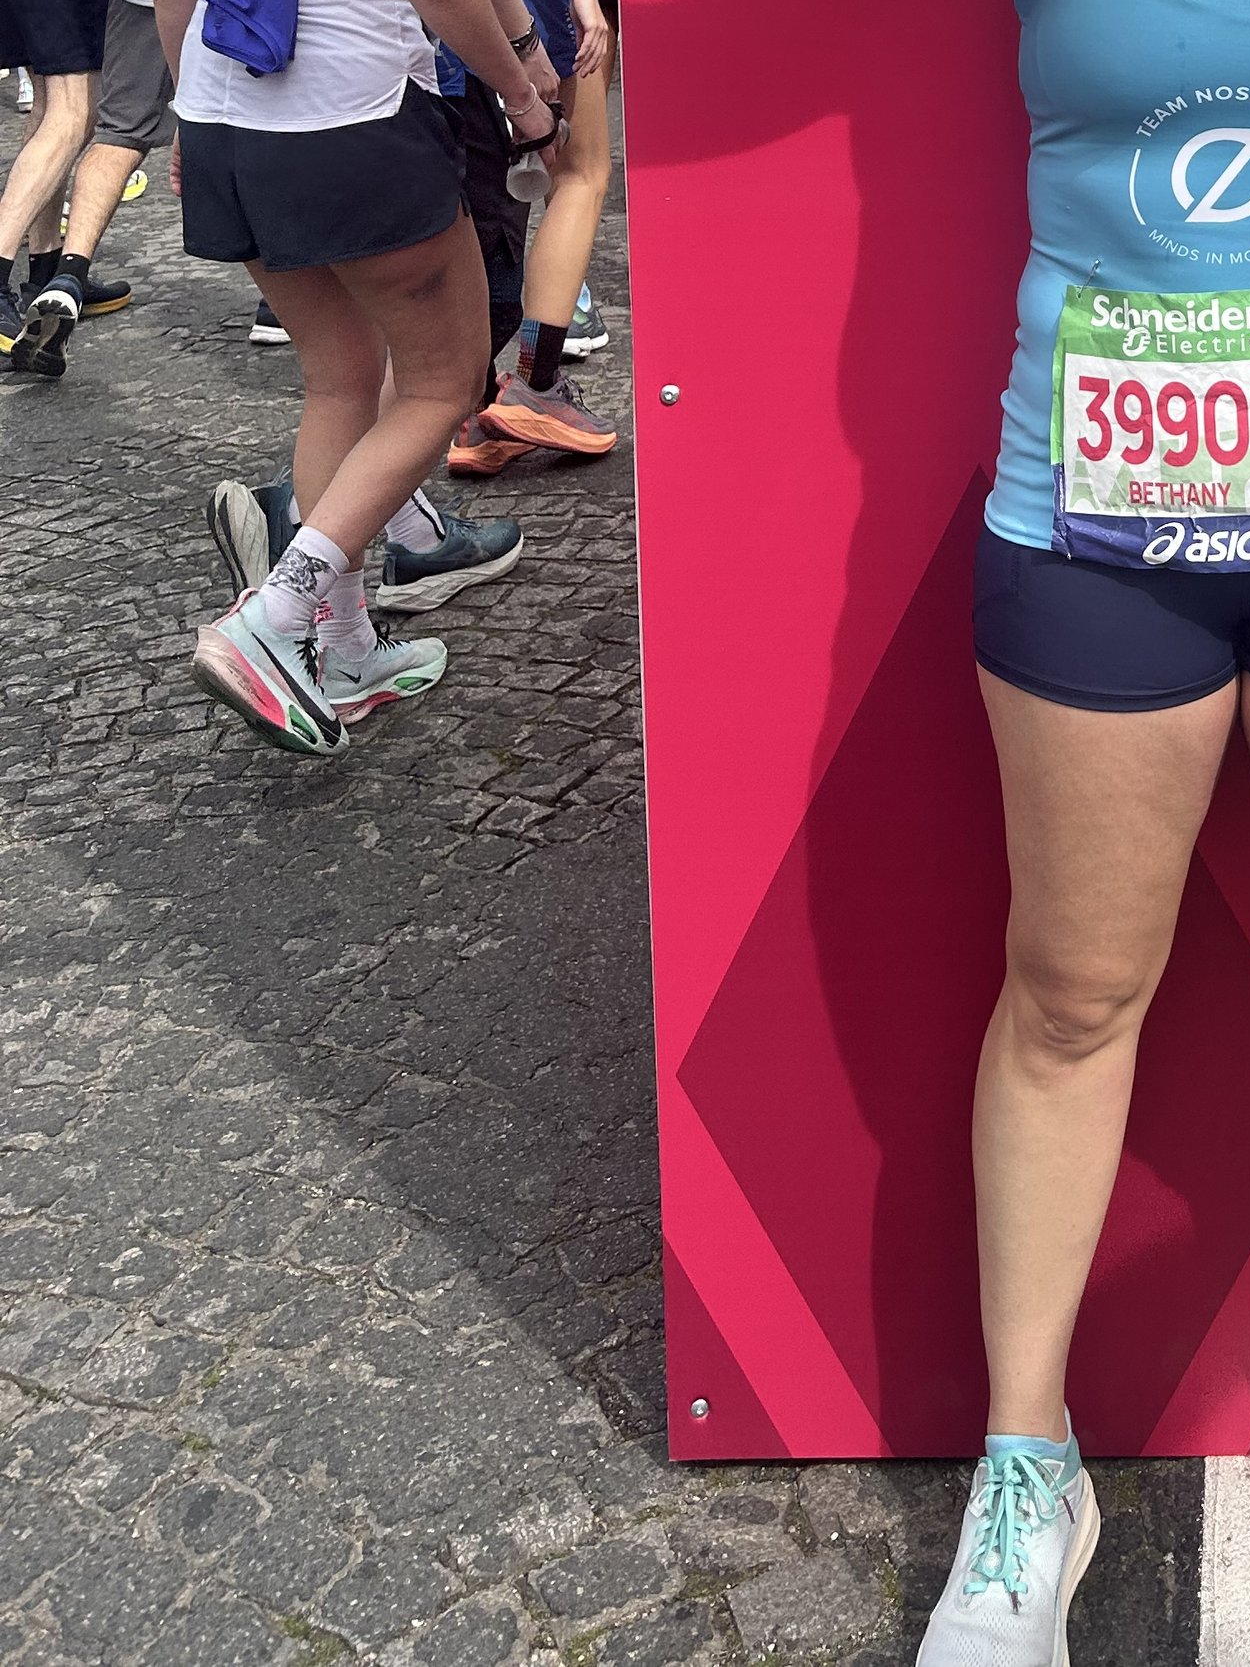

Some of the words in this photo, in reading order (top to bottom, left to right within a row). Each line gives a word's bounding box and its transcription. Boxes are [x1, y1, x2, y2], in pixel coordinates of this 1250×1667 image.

[1136, 95, 1189, 138] TEAM
[1149, 229, 1200, 262] MINDS
[1205, 252, 1223, 265] IN
[1129, 481, 1232, 506] BETHANY
